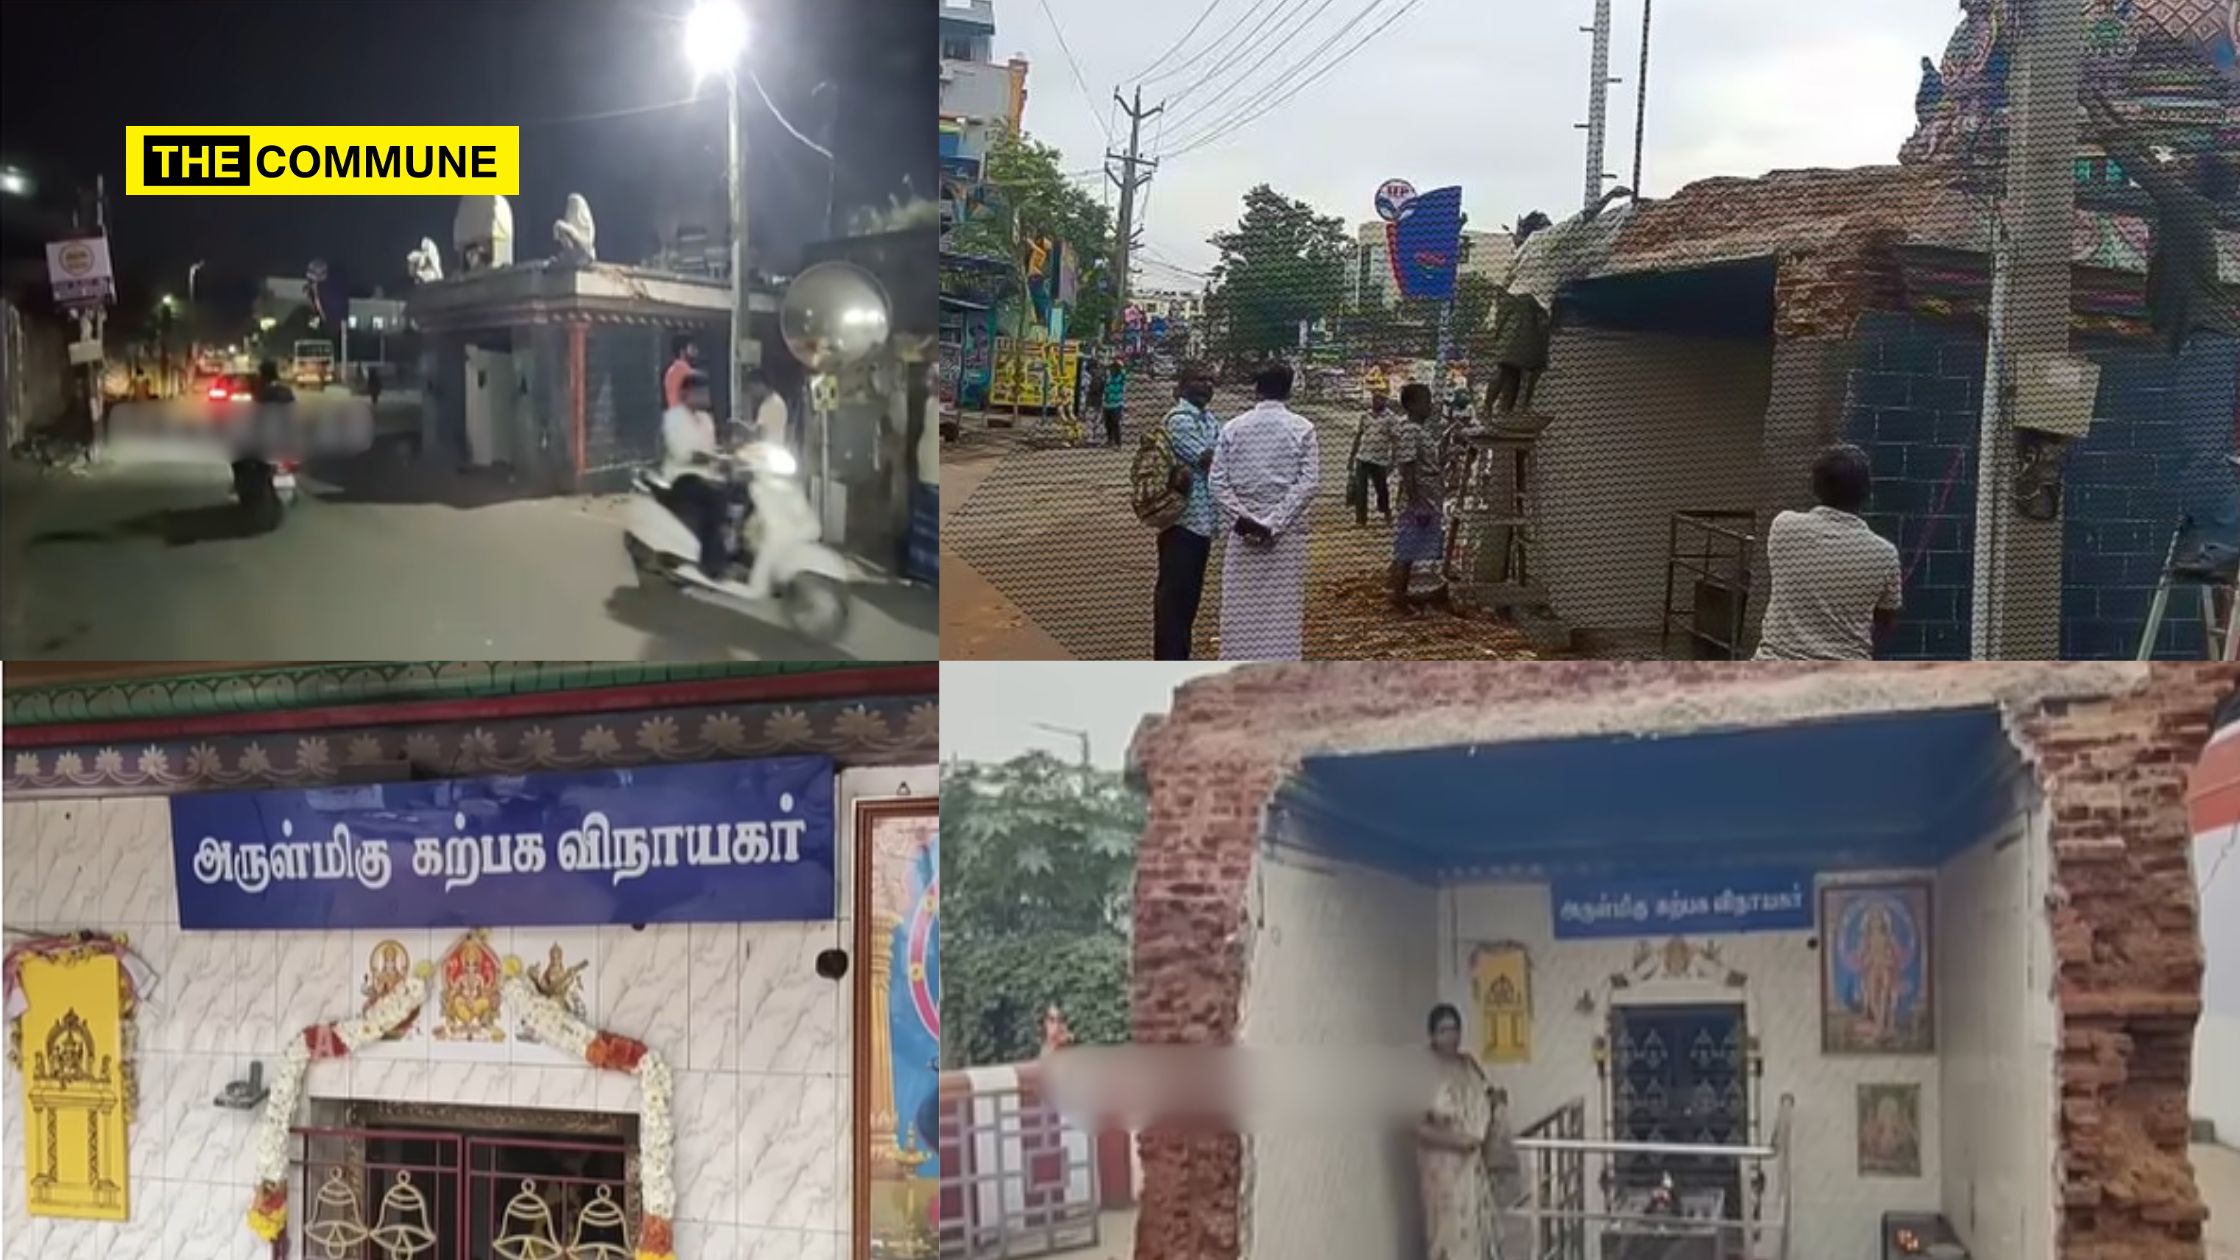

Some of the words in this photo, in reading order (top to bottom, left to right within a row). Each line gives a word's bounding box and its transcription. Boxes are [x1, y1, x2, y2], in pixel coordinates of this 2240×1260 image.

[193, 819, 392, 894] அருள்மிகு
[412, 811, 547, 892] கற்பக
[558, 792, 807, 886] விநாயகர்
[1560, 893, 1649, 925] அருள்மிகு
[1655, 889, 1709, 921] கற்பக
[1713, 882, 1802, 917] விநாயகர்
